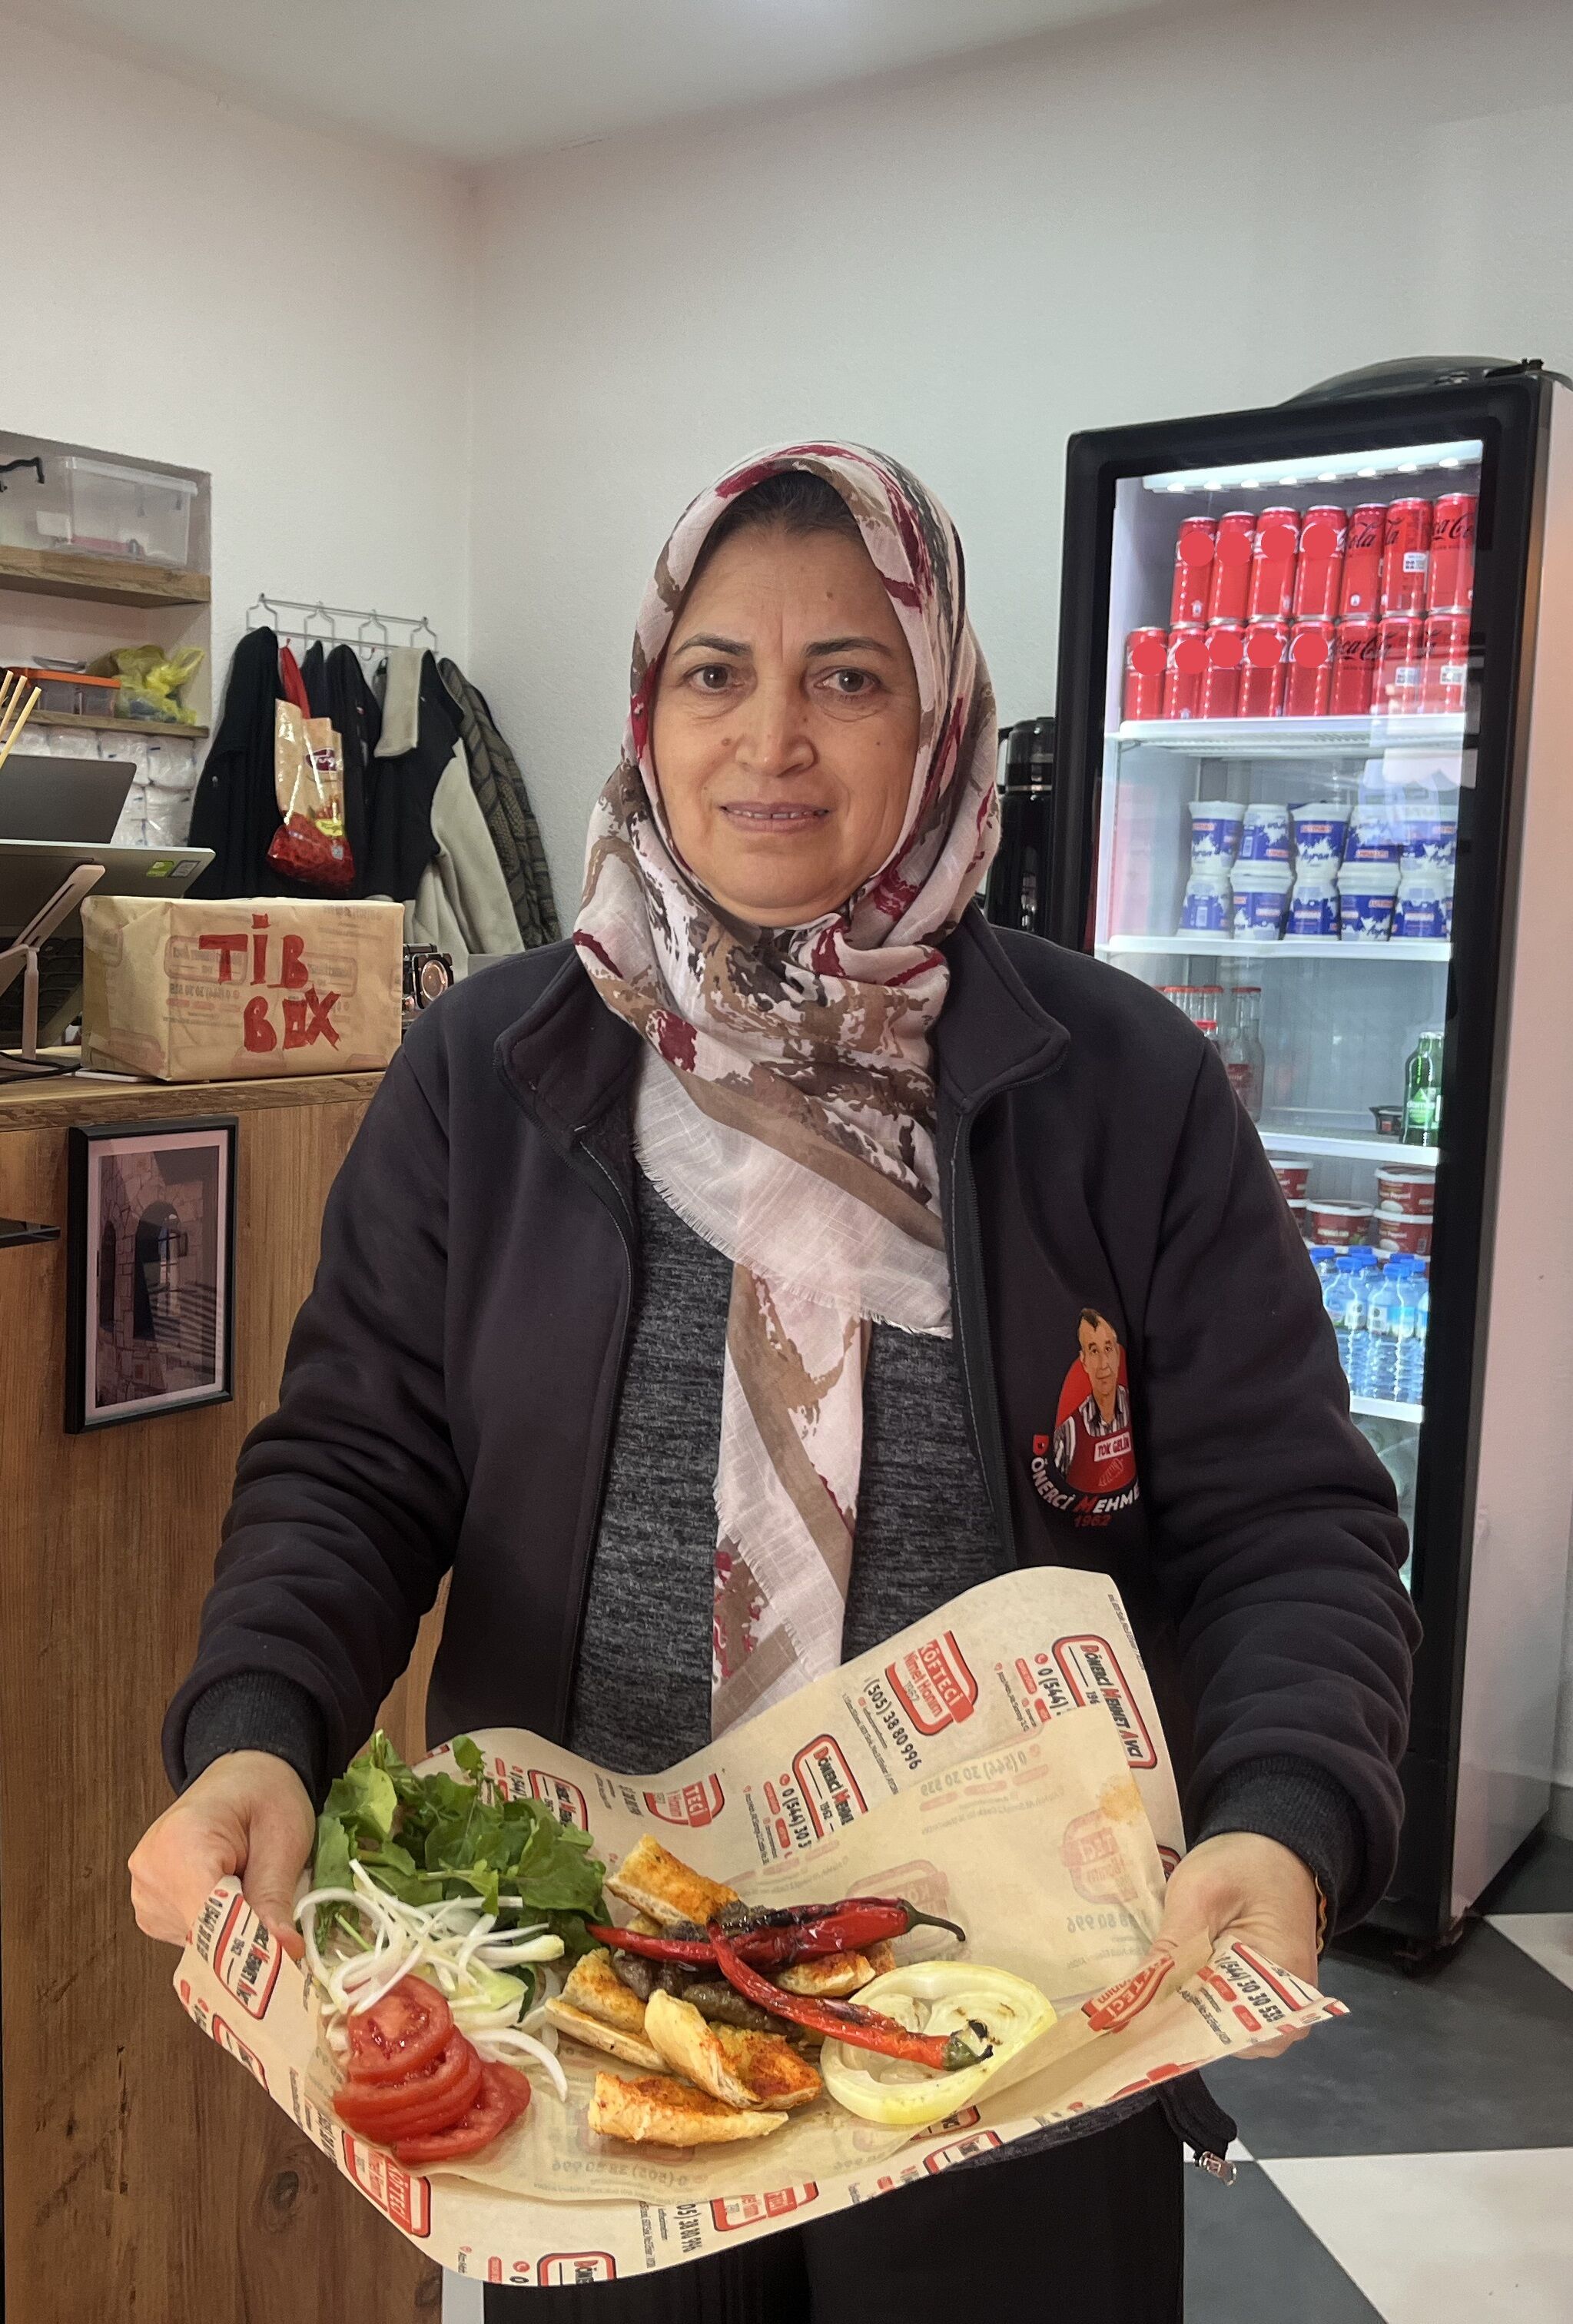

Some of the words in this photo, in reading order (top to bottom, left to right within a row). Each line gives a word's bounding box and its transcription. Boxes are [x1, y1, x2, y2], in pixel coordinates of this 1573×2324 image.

[882, 1710, 898, 1730] 38
[892, 1728, 907, 1745] 80
[901, 1742, 922, 1771] 996
